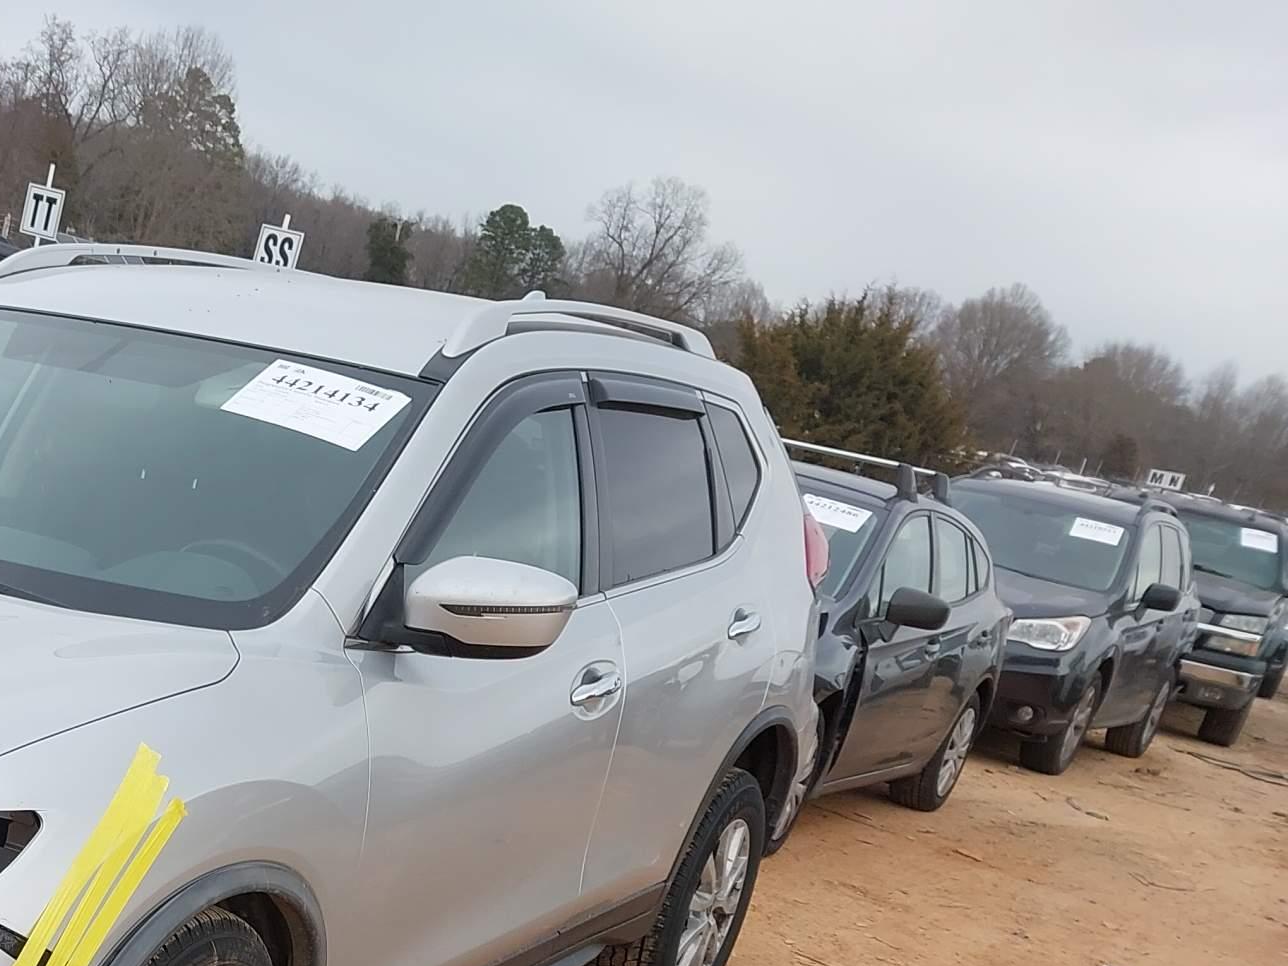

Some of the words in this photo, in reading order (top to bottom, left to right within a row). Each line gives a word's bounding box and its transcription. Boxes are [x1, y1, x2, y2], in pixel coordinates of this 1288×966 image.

[31, 192, 58, 231] TT
[260, 233, 294, 267] SS
[271, 374, 381, 413] 44214134
[1150, 471, 1165, 485] M
